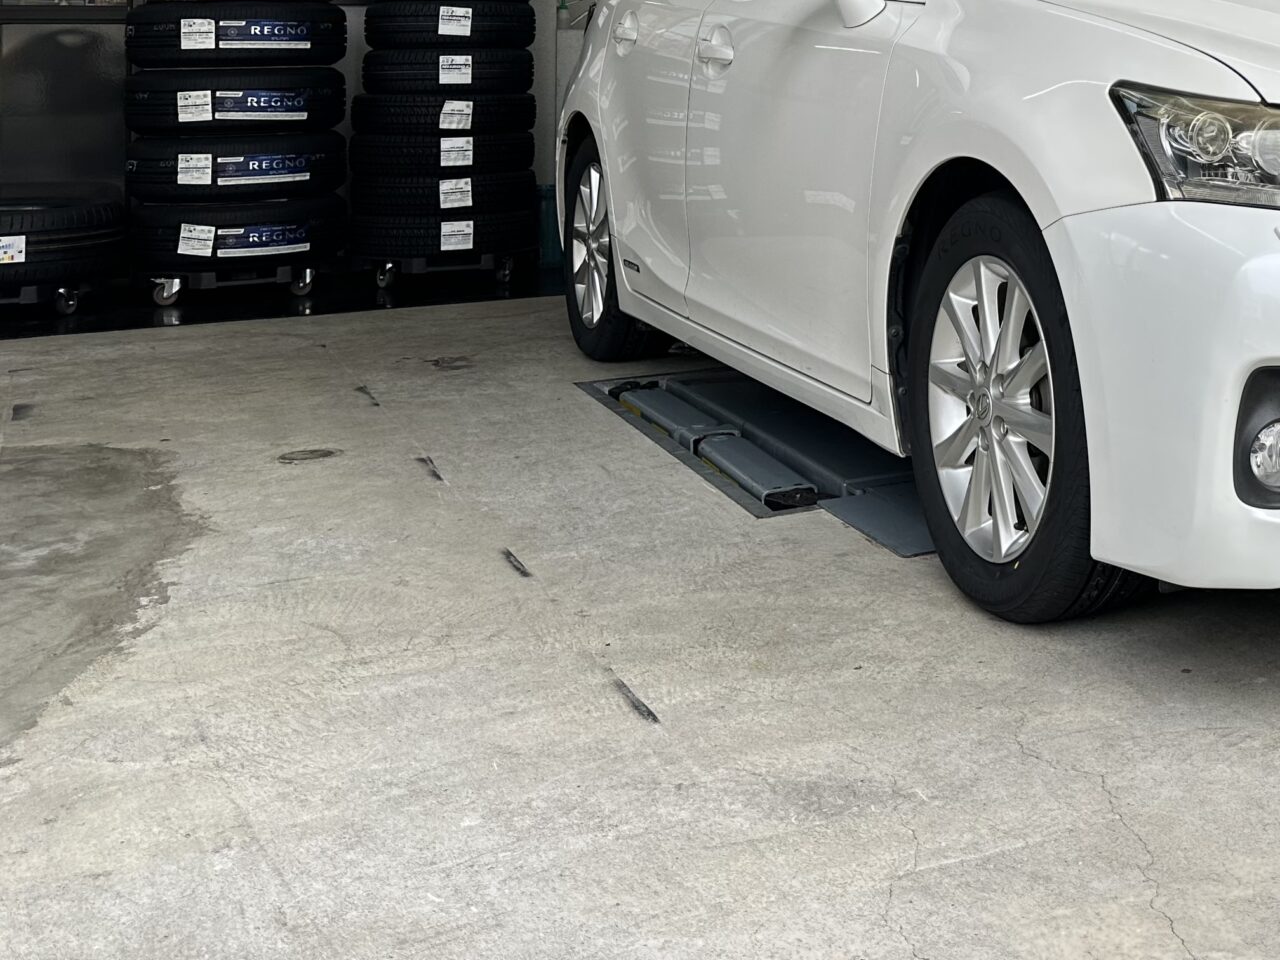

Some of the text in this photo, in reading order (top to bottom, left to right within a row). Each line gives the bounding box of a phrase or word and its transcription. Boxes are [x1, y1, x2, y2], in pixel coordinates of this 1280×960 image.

[250, 25, 307, 36] REGNO
[247, 97, 304, 108] REGNO
[249, 158, 306, 171] REGNO
[249, 230, 306, 243] REGNO
